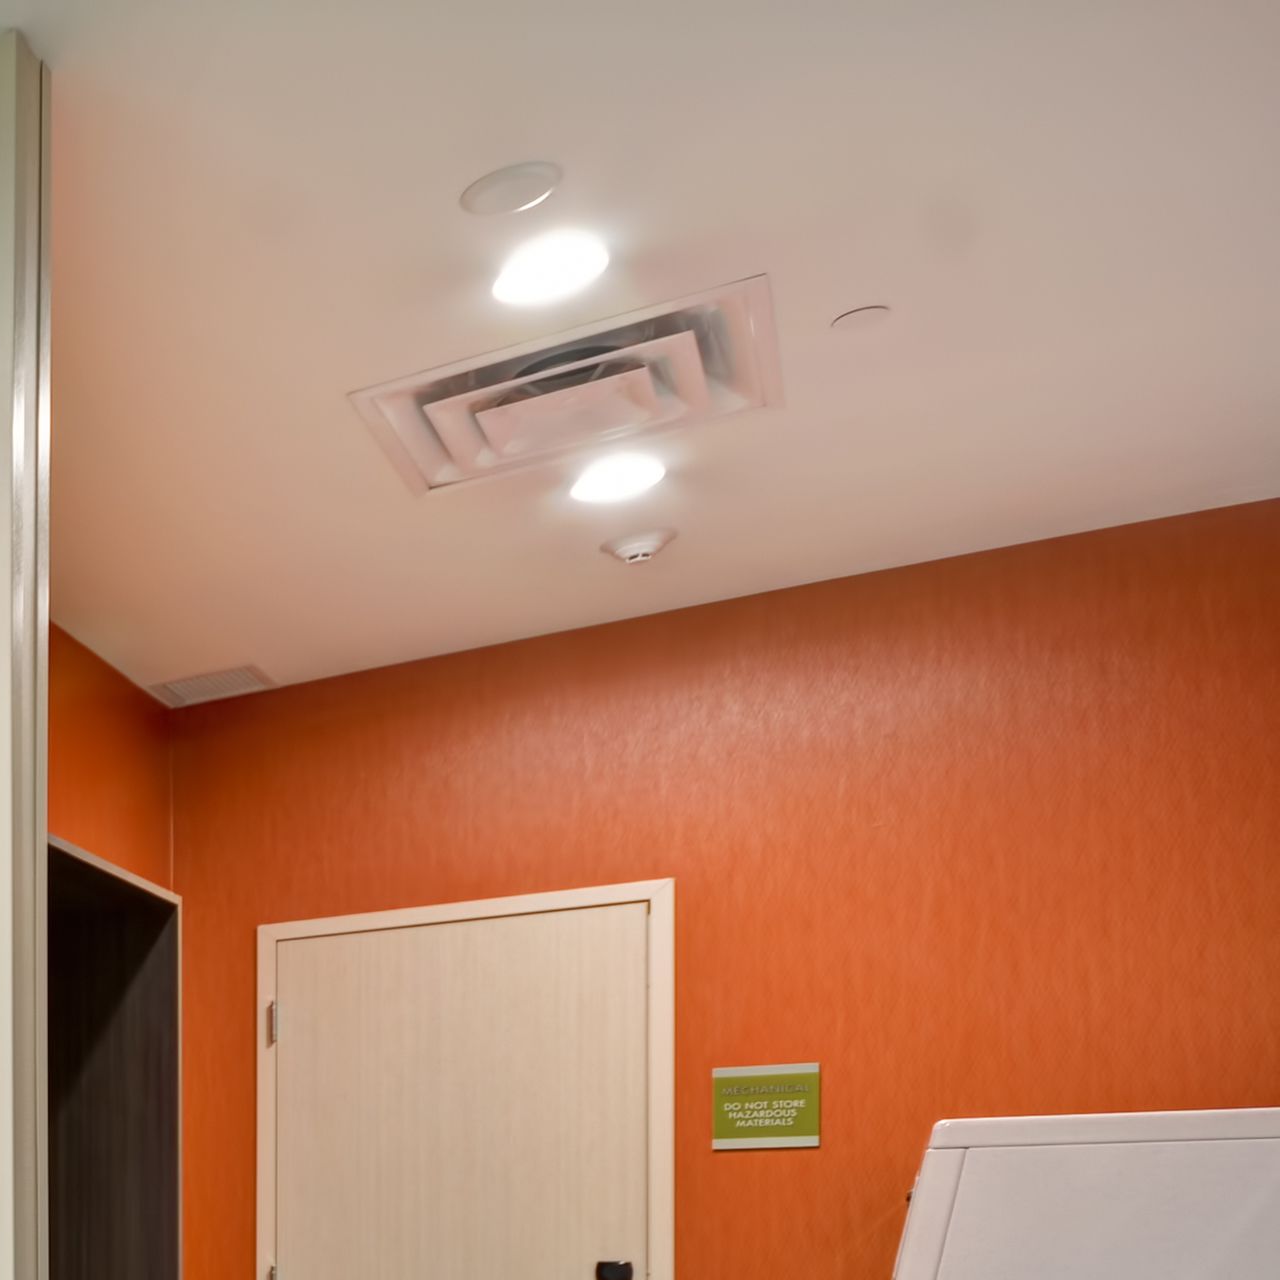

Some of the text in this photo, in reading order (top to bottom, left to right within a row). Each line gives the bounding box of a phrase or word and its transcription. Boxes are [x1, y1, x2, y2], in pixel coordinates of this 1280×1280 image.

[723, 1099, 806, 1111] DO NOT STORE
[728, 1108, 797, 1119] HAZARDOUS
[736, 1117, 794, 1128] MATERIALS
